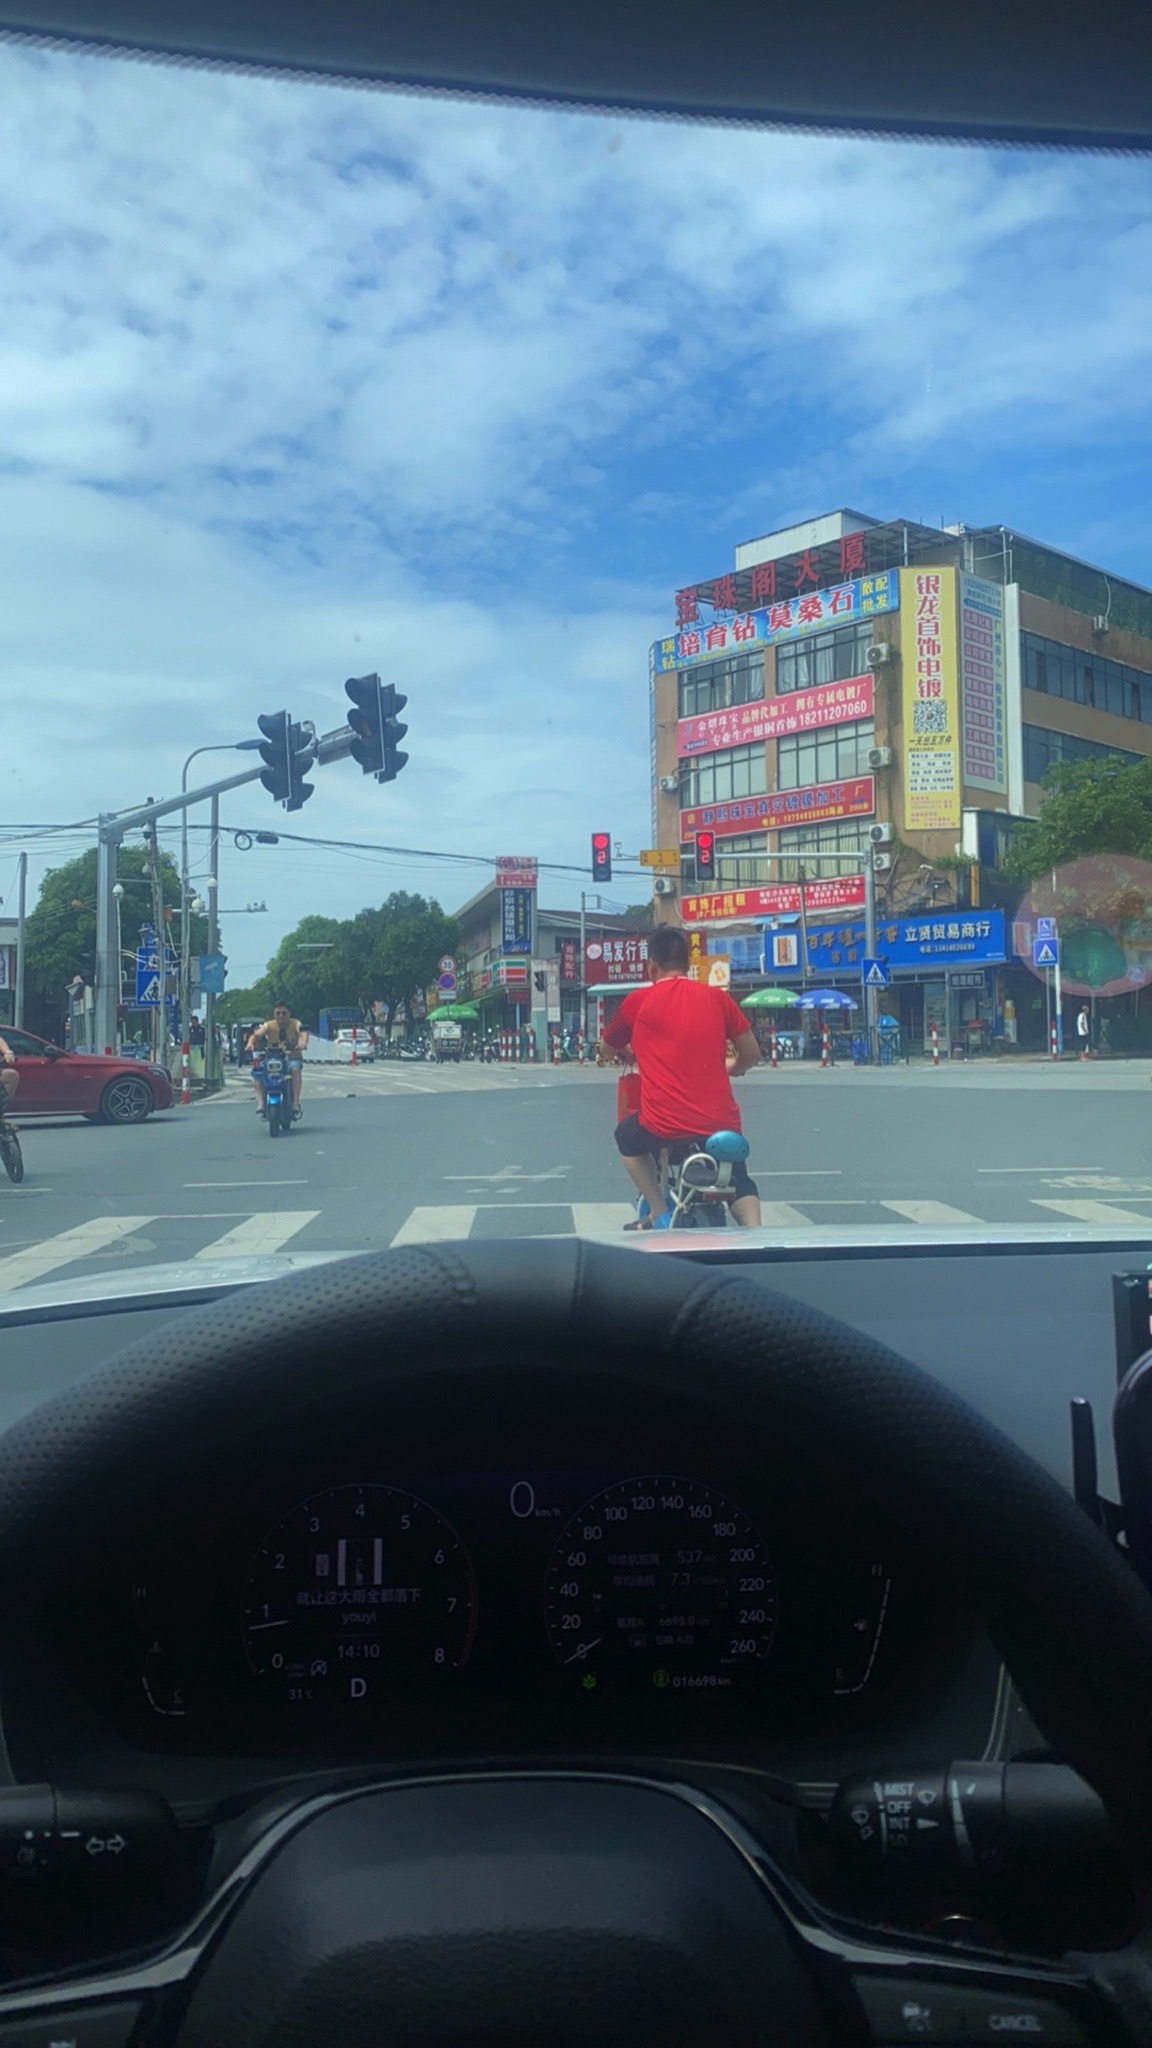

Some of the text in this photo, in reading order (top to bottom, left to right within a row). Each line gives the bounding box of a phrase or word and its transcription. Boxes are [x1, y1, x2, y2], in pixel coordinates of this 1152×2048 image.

[678, 612, 757, 659] 培育钻
[768, 584, 854, 634] 莫桑石
[916, 575, 942, 698] 银龙首饰电镀
[742, 702, 788, 724] 品牌代加工
[800, 700, 867, 727] 18211207060
[597, 852, 606, 864] 2
[701, 851, 709, 864] 2
[688, 893, 746, 912] 首饰厂招租
[905, 921, 990, 943] 立贤贸易商行
[510, 1481, 561, 1519] 0 km/h
[632, 1496, 655, 1510] 120
[660, 1495, 684, 1509] 140
[355, 1503, 365, 1518] 4
[604, 1507, 628, 1521] 100
[688, 1505, 712, 1519] 160
[310, 1517, 320, 1532] 3
[401, 1515, 411, 1530] 5
[583, 1526, 602, 1540] 80
[713, 1523, 736, 1537] 180
[274, 1554, 285, 1569] 2
[434, 1550, 445, 1564] 6
[567, 1552, 587, 1566] 60
[677, 1551, 702, 1564] 537
[730, 1549, 755, 1562] 200
[671, 1573, 690, 1586] 7.3
[739, 1578, 764, 1592] 220
[296, 1588, 422, 1606] 就让这大雨全都落下
[559, 1583, 579, 1597] 40
[262, 1604, 269, 1618] 1
[447, 1598, 457, 1613] 7
[342, 1610, 377, 1626] youyi
[561, 1615, 581, 1629] 20
[739, 1609, 765, 1624] 240
[337, 1644, 381, 1659] 14:10
[730, 1640, 756, 1654] 260
[272, 1653, 283, 1668] 0
[434, 1648, 445, 1663] 8
[350, 1678, 367, 1698] D
[673, 1676, 717, 1687] 016698
[884, 1782, 915, 1796] MIST
[887, 1801, 912, 1814] OFF
[888, 1817, 910, 1830] INT
[989, 2014, 1042, 2032] CANCEL
